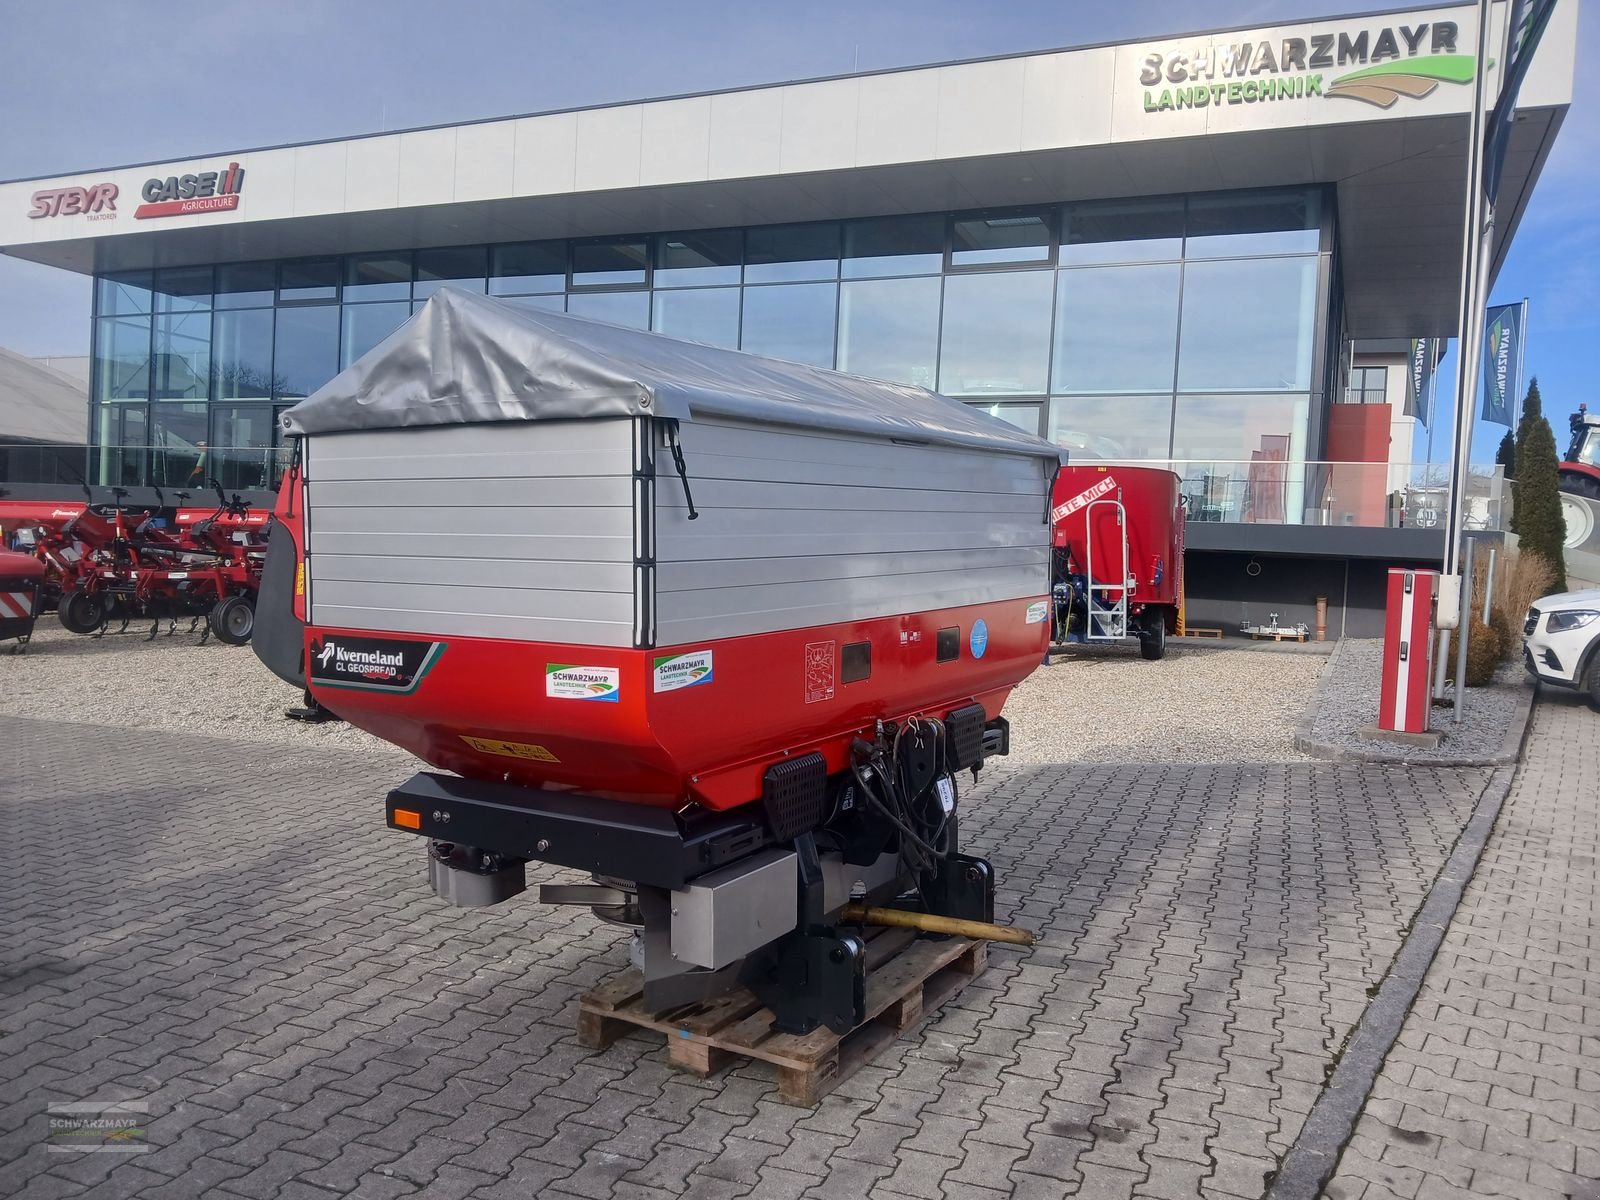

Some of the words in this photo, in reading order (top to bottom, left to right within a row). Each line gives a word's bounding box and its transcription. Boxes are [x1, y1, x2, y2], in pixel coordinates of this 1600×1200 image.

[1139, 21, 1459, 86] SCHWARZMAYR
[1143, 73, 1325, 112] LANDTECHNIK
[141, 171, 218, 203] CASE
[27, 182, 120, 219] STEYR
[181, 197, 233, 211] AGRICULTURE
[86, 213, 117, 222] TRAKTOREN
[1081, 477, 1116, 503] MICH
[336, 646, 403, 667] Kverneland
[659, 659, 705, 674] SCHWARZMAYR
[336, 662, 346, 672] CL
[347, 663, 397, 676] GEOSPREAD
[552, 672, 609, 683] SCHWARZMAYR
